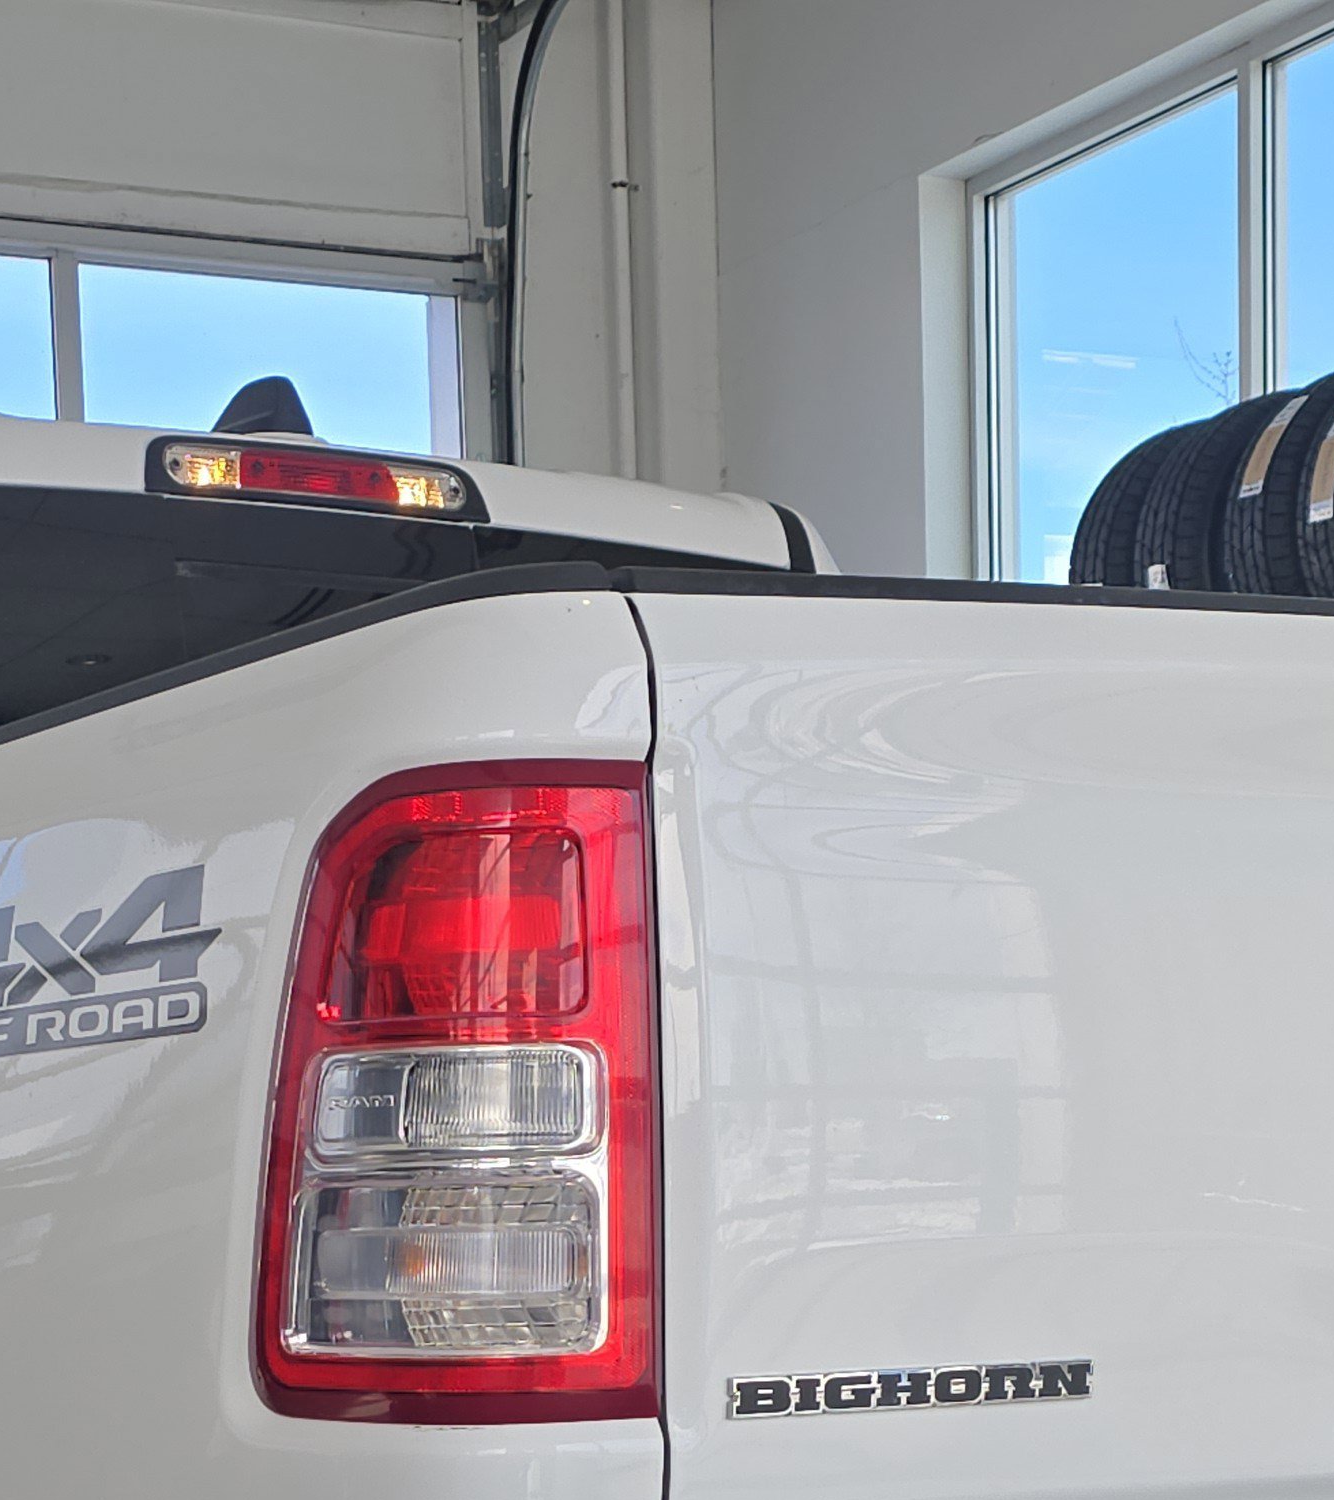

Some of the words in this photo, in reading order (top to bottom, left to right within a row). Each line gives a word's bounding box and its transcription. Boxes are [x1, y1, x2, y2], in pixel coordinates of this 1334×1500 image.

[26, 991, 200, 1045] ROAD
[328, 1094, 395, 1110] RAM
[726, 1359, 1093, 1420] BIGHORN
